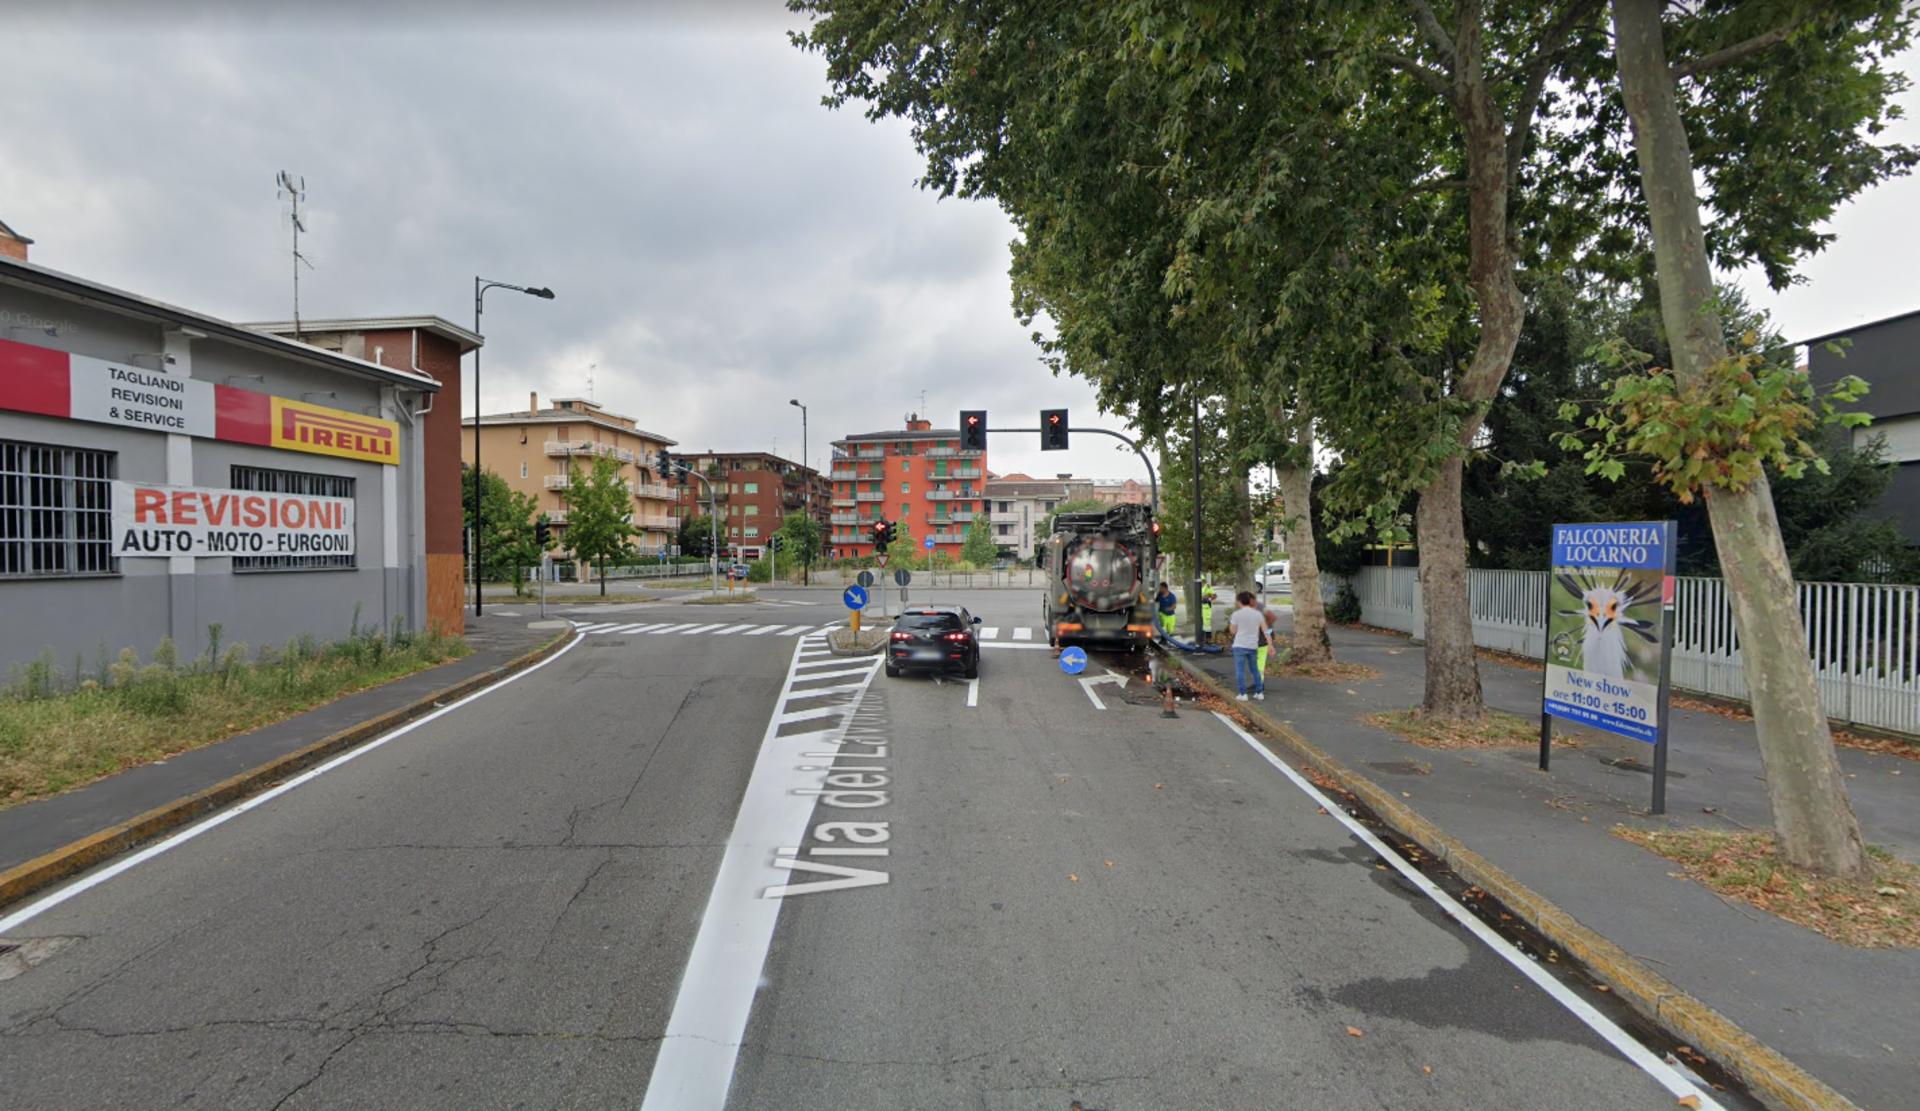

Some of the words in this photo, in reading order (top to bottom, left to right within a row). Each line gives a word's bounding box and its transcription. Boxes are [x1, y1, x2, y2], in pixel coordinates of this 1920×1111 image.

[108, 367, 184, 393] TAGLIANDI
[111, 387, 183, 411] REVISIONI
[109, 407, 120, 420] &
[123, 408, 185, 429] SERVICE
[281, 407, 392, 456] PIRELLI
[134, 488, 343, 530] REVISIONI
[1557, 528, 1660, 546] FALCONERIA
[1566, 546, 1647, 564] LOCARNO
[1566, 671, 1592, 689] New
[1595, 678, 1632, 698] show
[1553, 689, 1569, 700] ore
[1571, 691, 1601, 711] 11:00
[1603, 702, 1610, 712] e
[1612, 702, 1647, 721] 15:00
